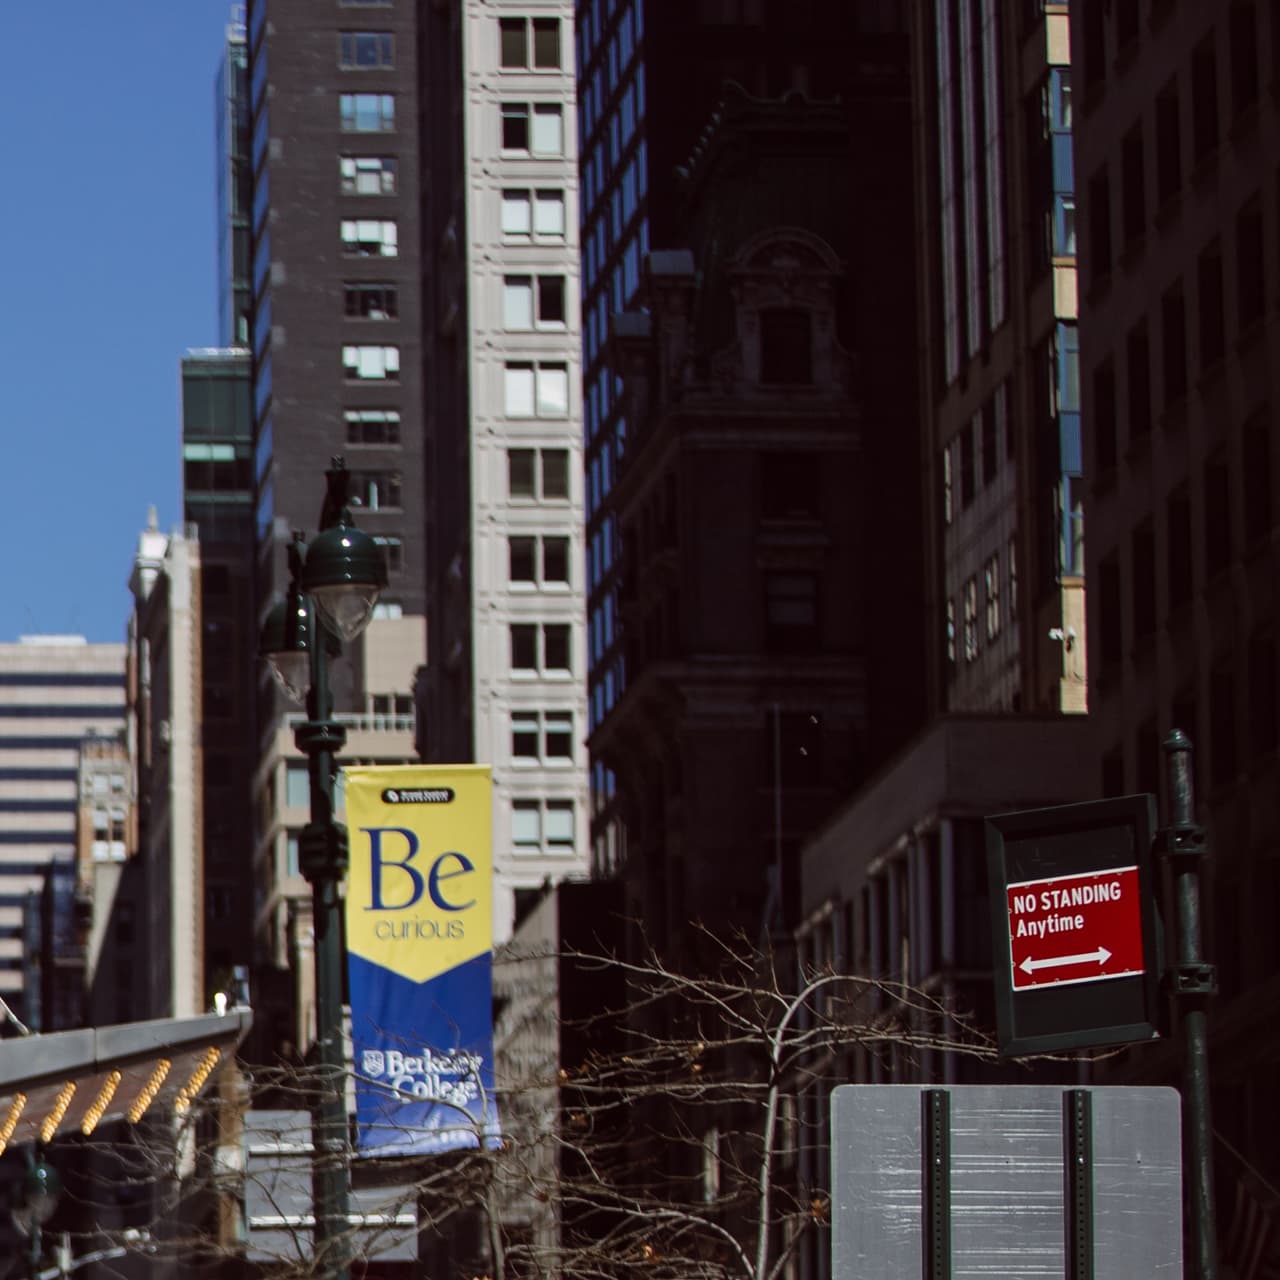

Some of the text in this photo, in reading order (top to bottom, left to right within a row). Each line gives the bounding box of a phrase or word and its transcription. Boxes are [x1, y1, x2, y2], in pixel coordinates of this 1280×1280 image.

[359, 827, 477, 912] Be
[1014, 881, 1122, 914] NO STANDING
[375, 915, 466, 940] curious
[1017, 912, 1085, 939] Anytime
[384, 1047, 484, 1080] Berkeley
[391, 1074, 479, 1106] College
